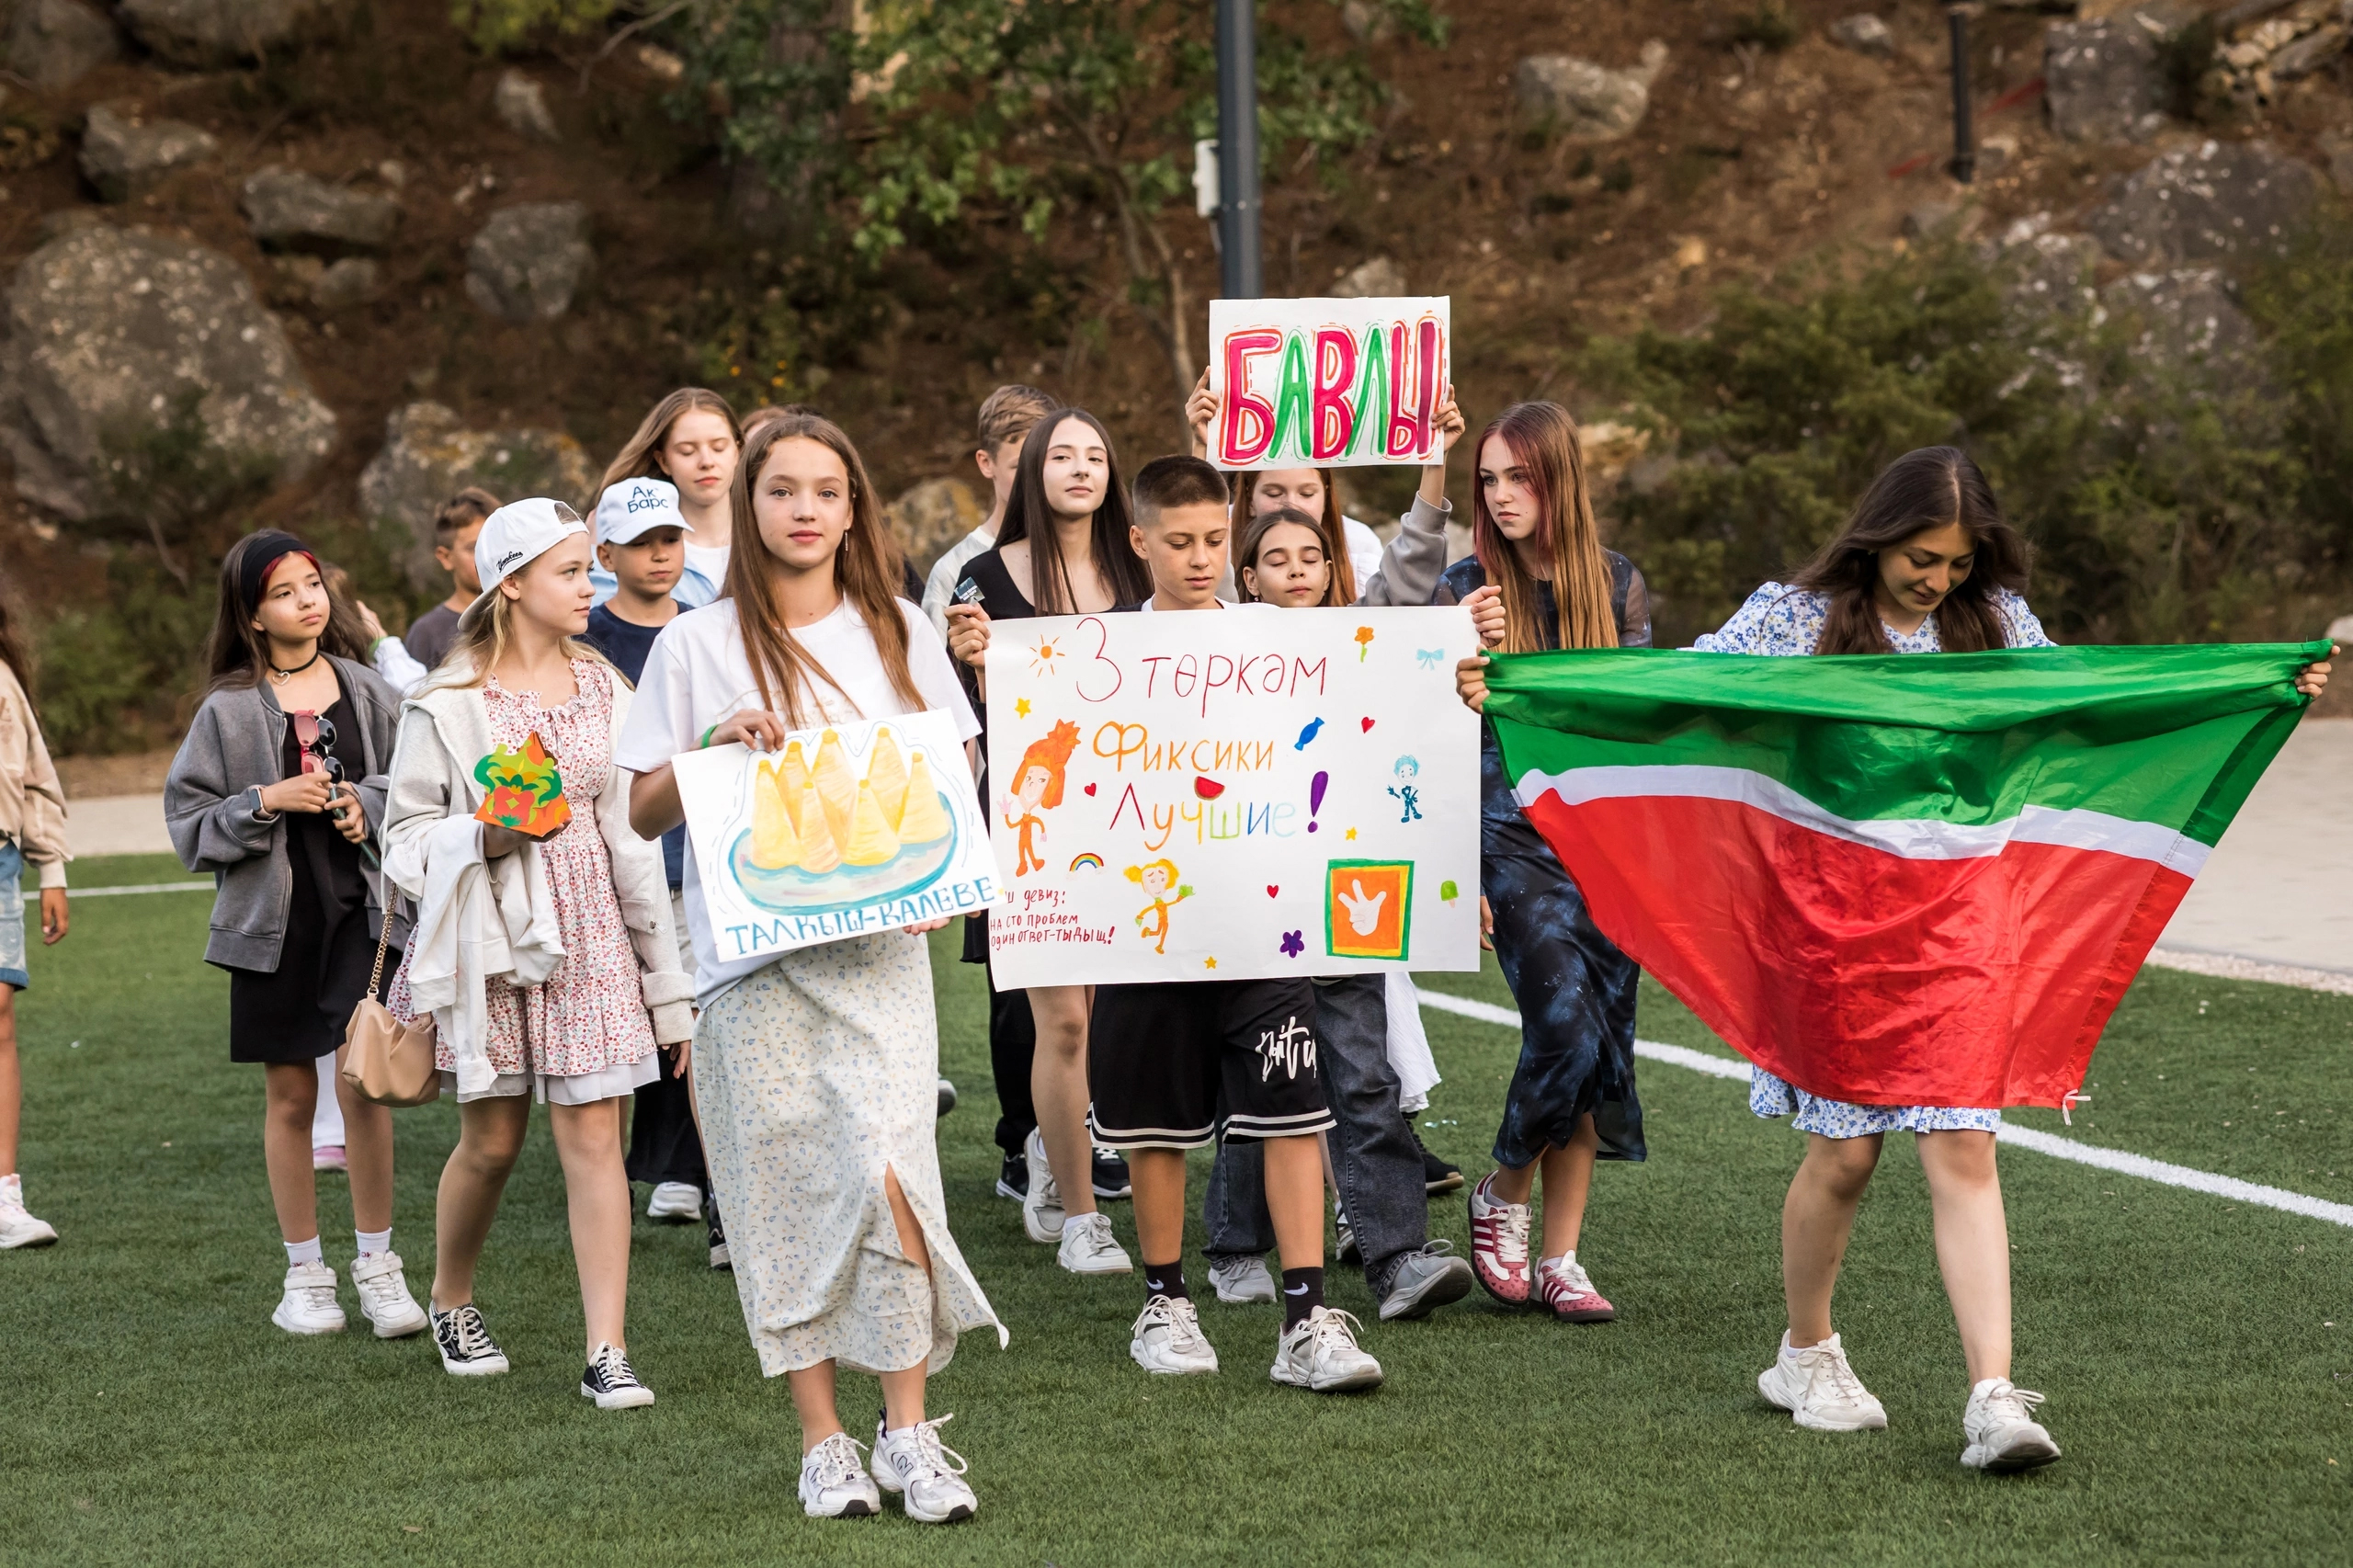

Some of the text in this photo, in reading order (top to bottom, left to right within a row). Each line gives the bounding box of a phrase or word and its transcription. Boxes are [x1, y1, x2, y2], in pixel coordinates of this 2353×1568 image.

[1220, 316, 1443, 465] БАВЛЫ
[627, 498, 669, 514] Барс
[632, 485, 656, 499] Ак
[1092, 721, 1275, 773] Фиксики
[1108, 770, 1329, 852] Лучшие!
[725, 876, 995, 955] ТАЛКЫШ-КАЛЕВЕ
[1024, 889, 1066, 911] девиз:
